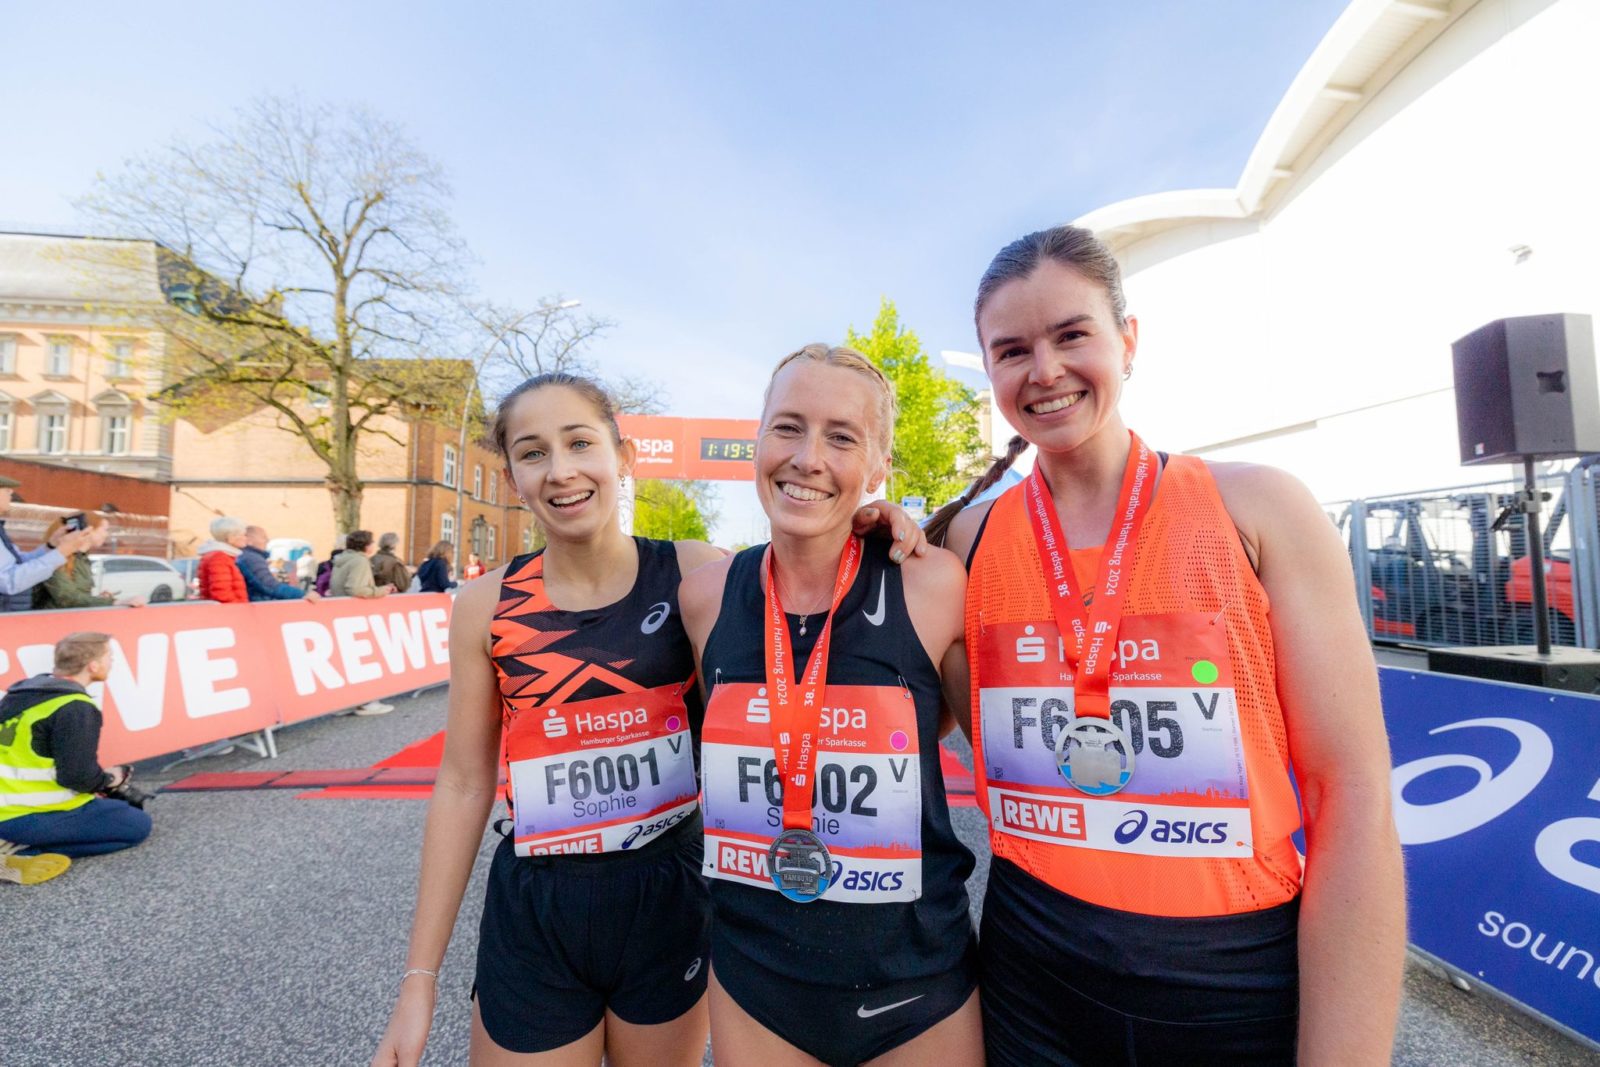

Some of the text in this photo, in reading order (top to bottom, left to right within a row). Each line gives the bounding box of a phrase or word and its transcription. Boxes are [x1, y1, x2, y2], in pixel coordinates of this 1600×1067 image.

[631, 438, 674, 456] aspa
[1108, 522, 1134, 566] Hamburg
[1050, 551, 1065, 580] Haspa
[1058, 581, 1070, 598] 38.
[1104, 569, 1121, 597] 2024
[281, 608, 450, 696] REWE
[772, 627, 786, 674] Hamburg
[1085, 637, 1104, 675] Haspa
[0, 627, 251, 732] WE
[807, 652, 823, 685] Haspa
[1113, 672, 1162, 683] Sparkasse
[776, 678, 789, 706] 2024
[804, 688, 816, 707] 38.
[575, 707, 648, 733] Haspa
[820, 706, 867, 734] spa
[1011, 697, 1184, 759] F605
[1192, 692, 1220, 721] V
[580, 730, 650, 746] Hamburger Sparkasse
[797, 733, 813, 770] Haspa
[825, 738, 867, 748] Sparkasse
[544, 747, 661, 805] F6001
[667, 735, 682, 754] V
[738, 756, 878, 817] F602
[888, 758, 909, 783] V
[573, 793, 637, 819] Sophie
[1003, 800, 1228, 844] REWE asics
[721, 846, 904, 892] REW asics
